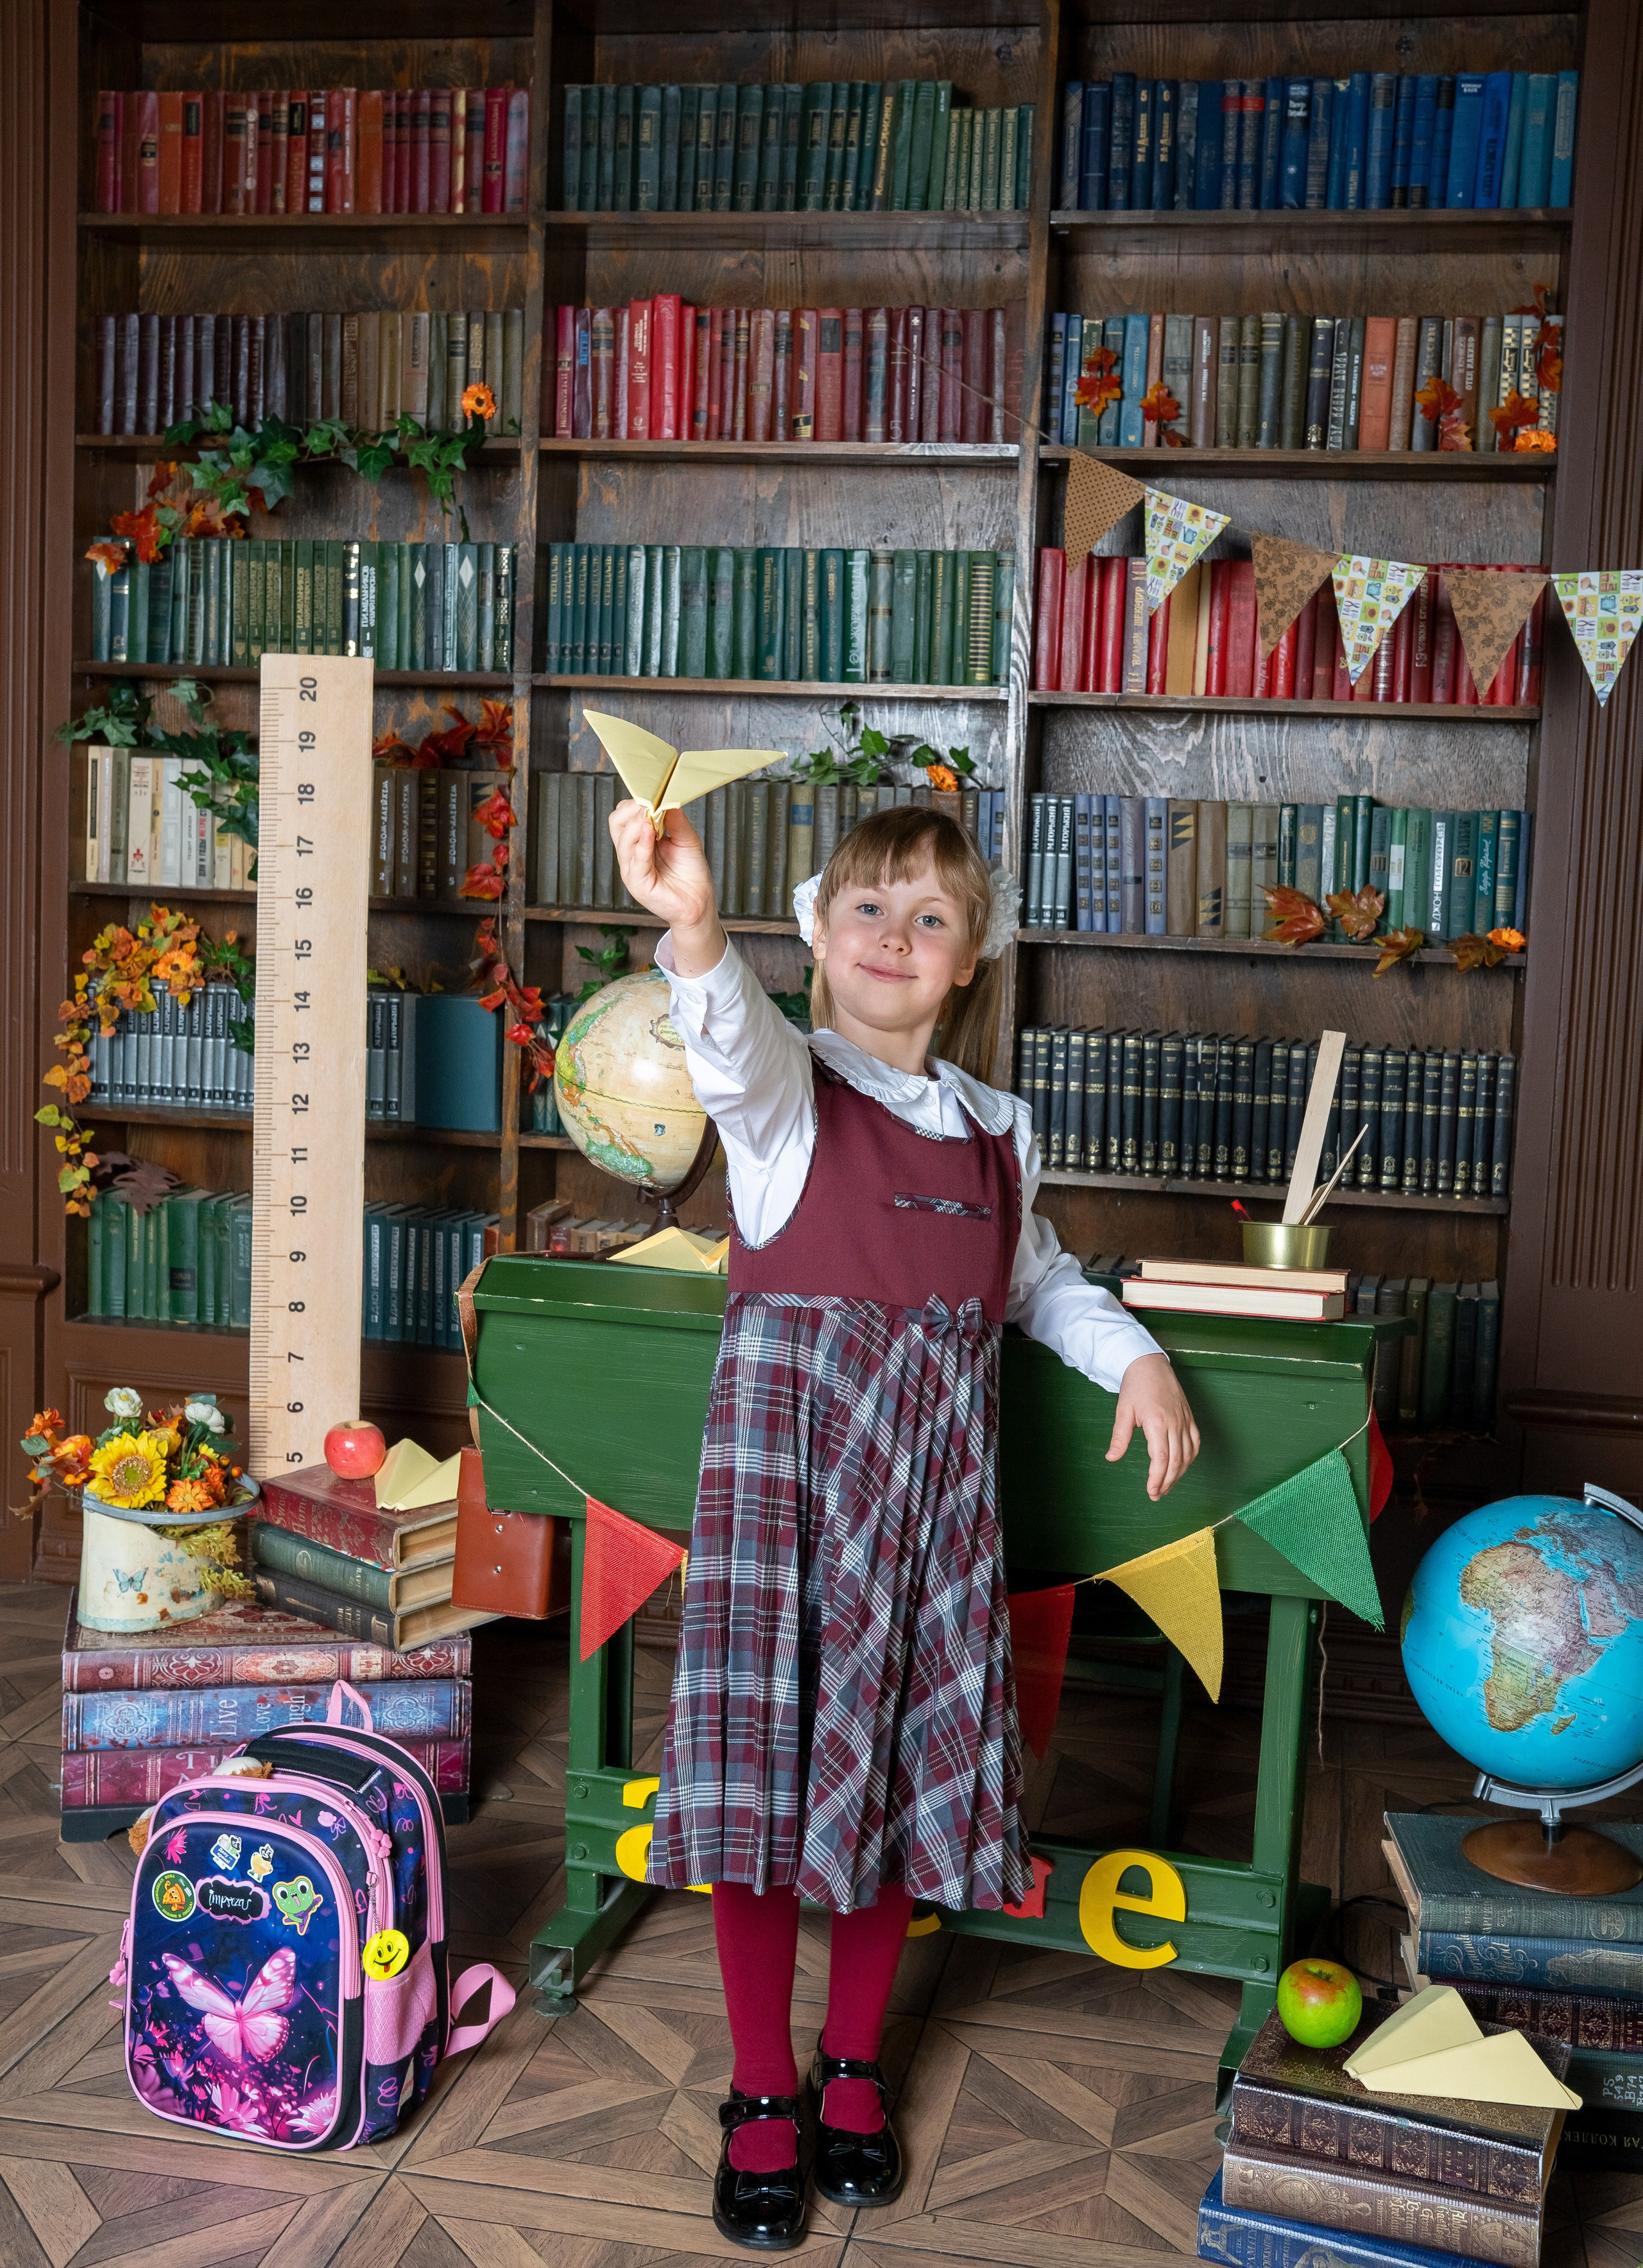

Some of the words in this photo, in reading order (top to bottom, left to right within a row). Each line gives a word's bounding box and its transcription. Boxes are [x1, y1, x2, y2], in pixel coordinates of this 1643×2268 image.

[879, 96, 894, 148] СИМОНОВ
[578, 330, 589, 366] ВЕТЕР
[890, 420, 902, 440] 5
[1133, 586, 1144, 627] ШЕКСПИР
[850, 607, 861, 639] ЖОРЖ
[366, 632, 370, 641] 1
[1132, 632, 1142, 667] ВИЛЬЯМ
[300, 677, 318, 702] 20
[298, 731, 316, 752] 19
[298, 783, 315, 806] 18
[379, 780, 388, 860] ШОЛОМ-АЛЕЙХЕМ
[401, 784, 409, 864] ШОЛОМ-АЛЕЙХЕМ
[1032, 805, 1041, 850] М.ГОРЬКИЙ
[1047, 806, 1056, 850] М.ГОРЬКИЙ
[1062, 806, 1071, 851] М.ГОРЬКИЙ
[297, 836, 313, 856] 17
[1434, 823, 1445, 888] ГОЛСУОРСИ
[1457, 860, 1470, 875] 12
[449, 877, 455, 885] 5
[295, 888, 313, 908] 16
[1432, 892, 1441, 922] ДЖОН
[295, 940, 312, 960] 15
[294, 991, 310, 1011] 14
[293, 1043, 310, 1063] 13
[292, 1094, 309, 1114] 12
[291, 1148, 307, 1164] 11
[290, 1195, 307, 1216] 10
[289, 1251, 306, 1262] 9
[288, 1301, 305, 1312] 8
[288, 1352, 304, 1363] 7
[287, 1401, 304, 1413] 6
[286, 1452, 303, 1463] 5
[1408, 1656, 1444, 1686] АТЛАНТИЧЕСКИЙ
[1445, 1684, 1464, 1699] ОКЕАН
[209, 1699, 237, 1737] Live
[250, 1702, 271, 1733] Love
[284, 1694, 311, 1723] ugh
[217, 1853, 231, 1864] время!
[218, 1847, 228, 1856] Делу
[155, 1879, 164, 1903] СУПЕРСИЛА
[162, 1908, 177, 1919] ЗНАНИЯ
[182, 1901, 193, 1916] ПИЦЦА!
[1603, 2077, 1615, 2097] PS
[1614, 2074, 1624, 2100] 549
[1624, 2075, 1637, 2102] B74
[1563, 2131, 1616, 2147] КОЛЛЕК
[1406, 2200, 1422, 2238] Britain
